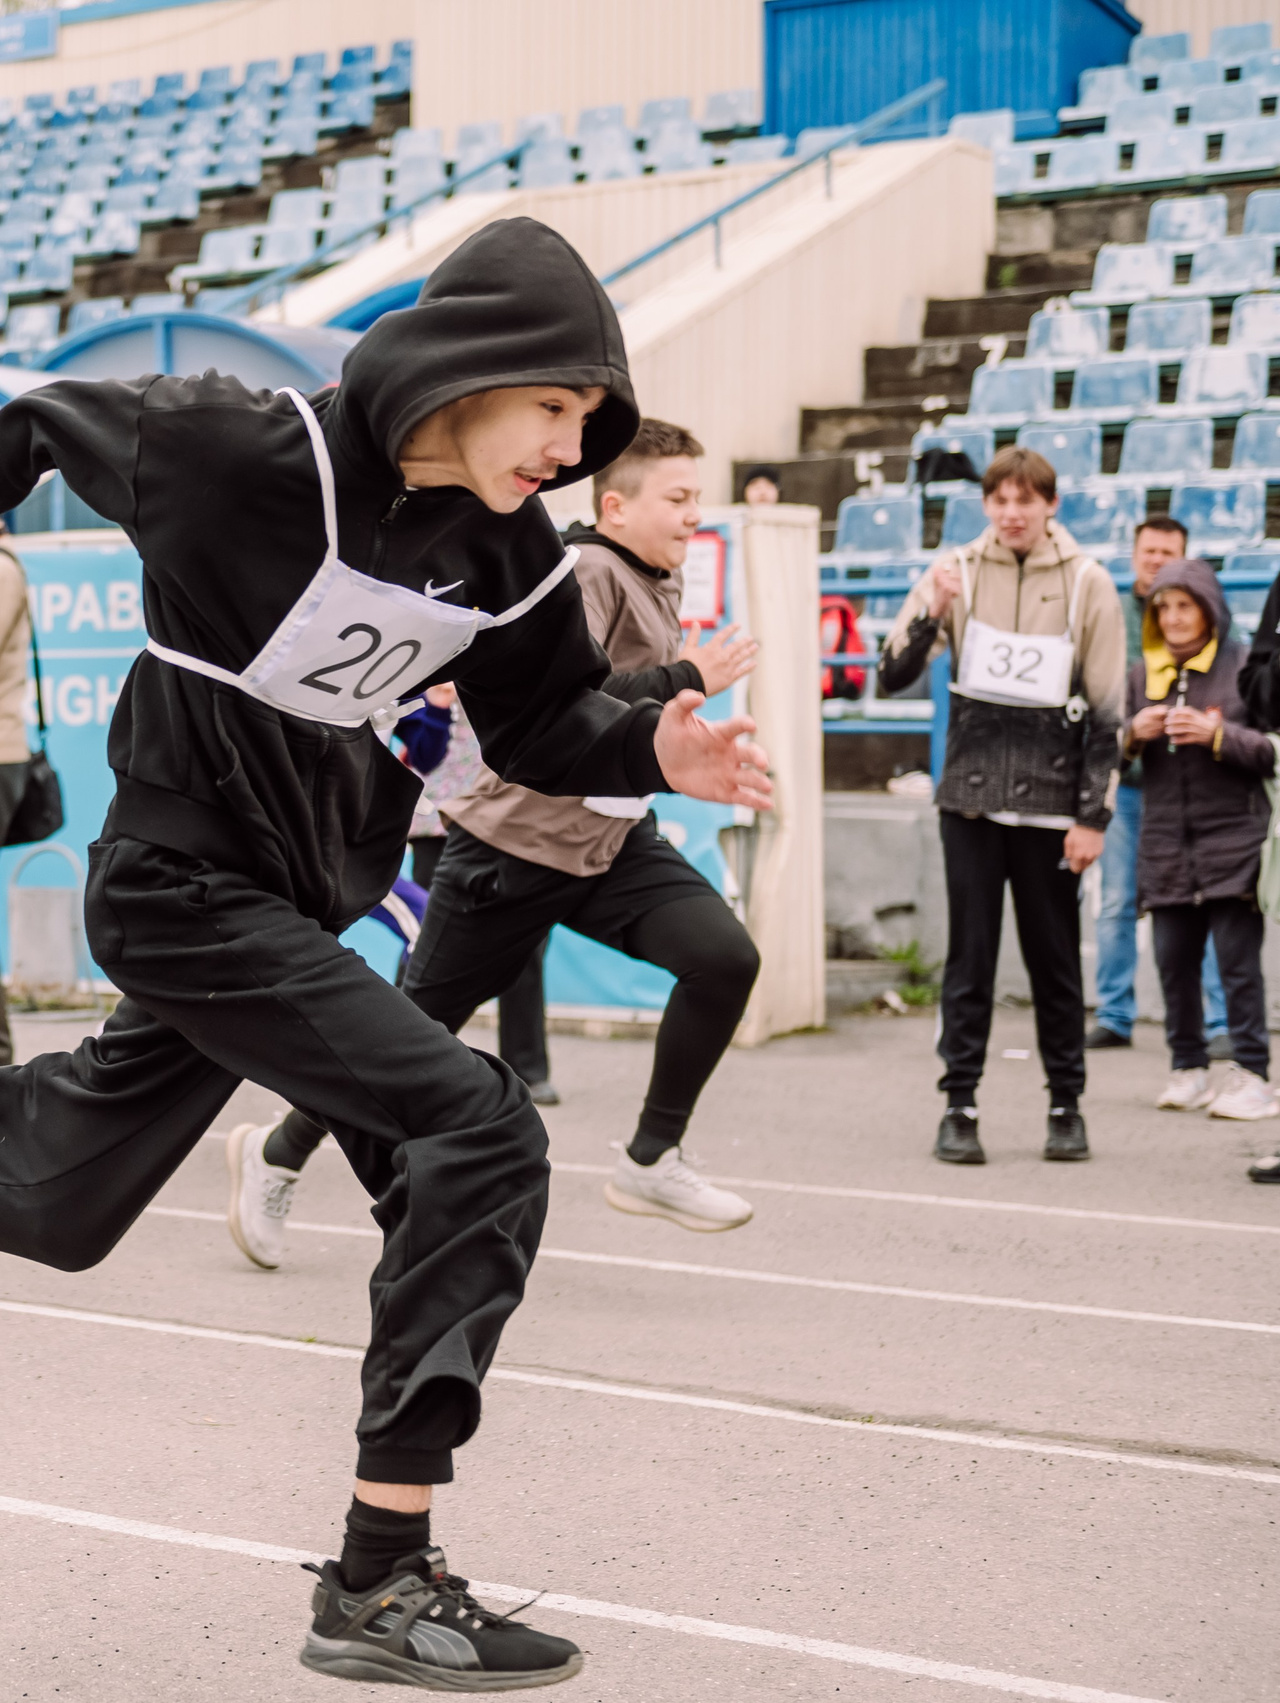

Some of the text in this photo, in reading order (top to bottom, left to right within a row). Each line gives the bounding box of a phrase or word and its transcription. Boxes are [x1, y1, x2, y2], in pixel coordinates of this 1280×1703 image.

[28, 580, 146, 632] РАВ
[298, 623, 422, 700] 20
[987, 641, 1043, 685] 32
